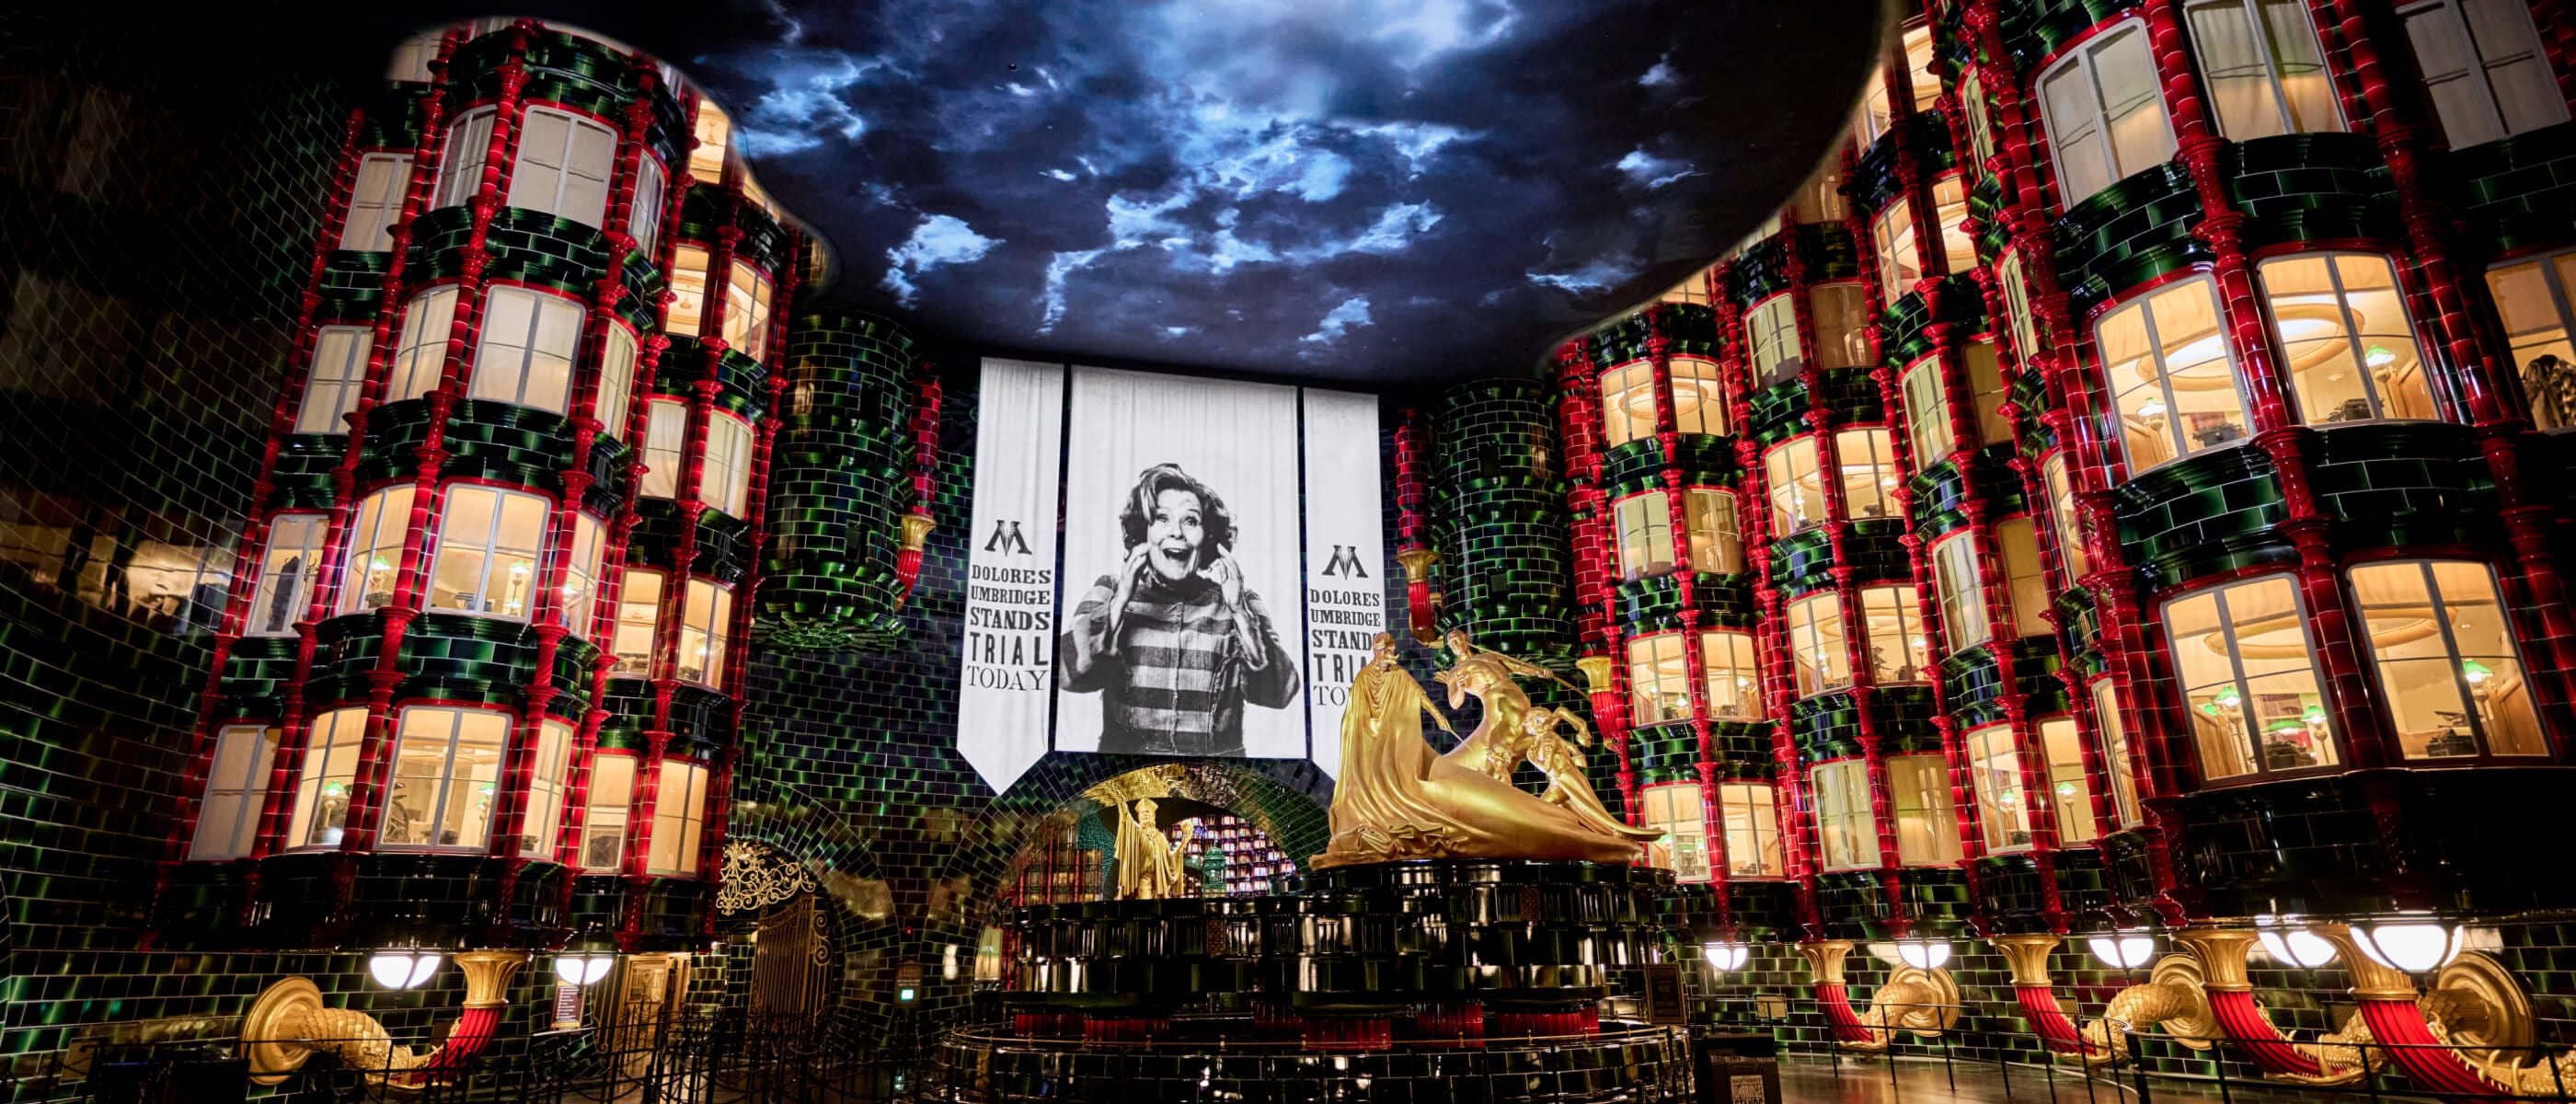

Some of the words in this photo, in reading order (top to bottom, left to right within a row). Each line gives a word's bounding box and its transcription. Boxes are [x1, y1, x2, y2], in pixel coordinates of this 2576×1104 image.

[983, 519, 1033, 558] M
[971, 564, 1052, 584] DOLORES
[1321, 544, 1369, 581] M
[971, 585, 1051, 605] UMBRIDGE
[1309, 588, 1381, 607] DOLORES
[970, 605, 1051, 631] STANDS
[1310, 608, 1381, 627] UMBRIDGE
[969, 631, 1049, 665] TRIAL
[1311, 628, 1375, 651] STAND
[967, 666, 1048, 691] TODAY
[1313, 652, 1367, 684] TRI
